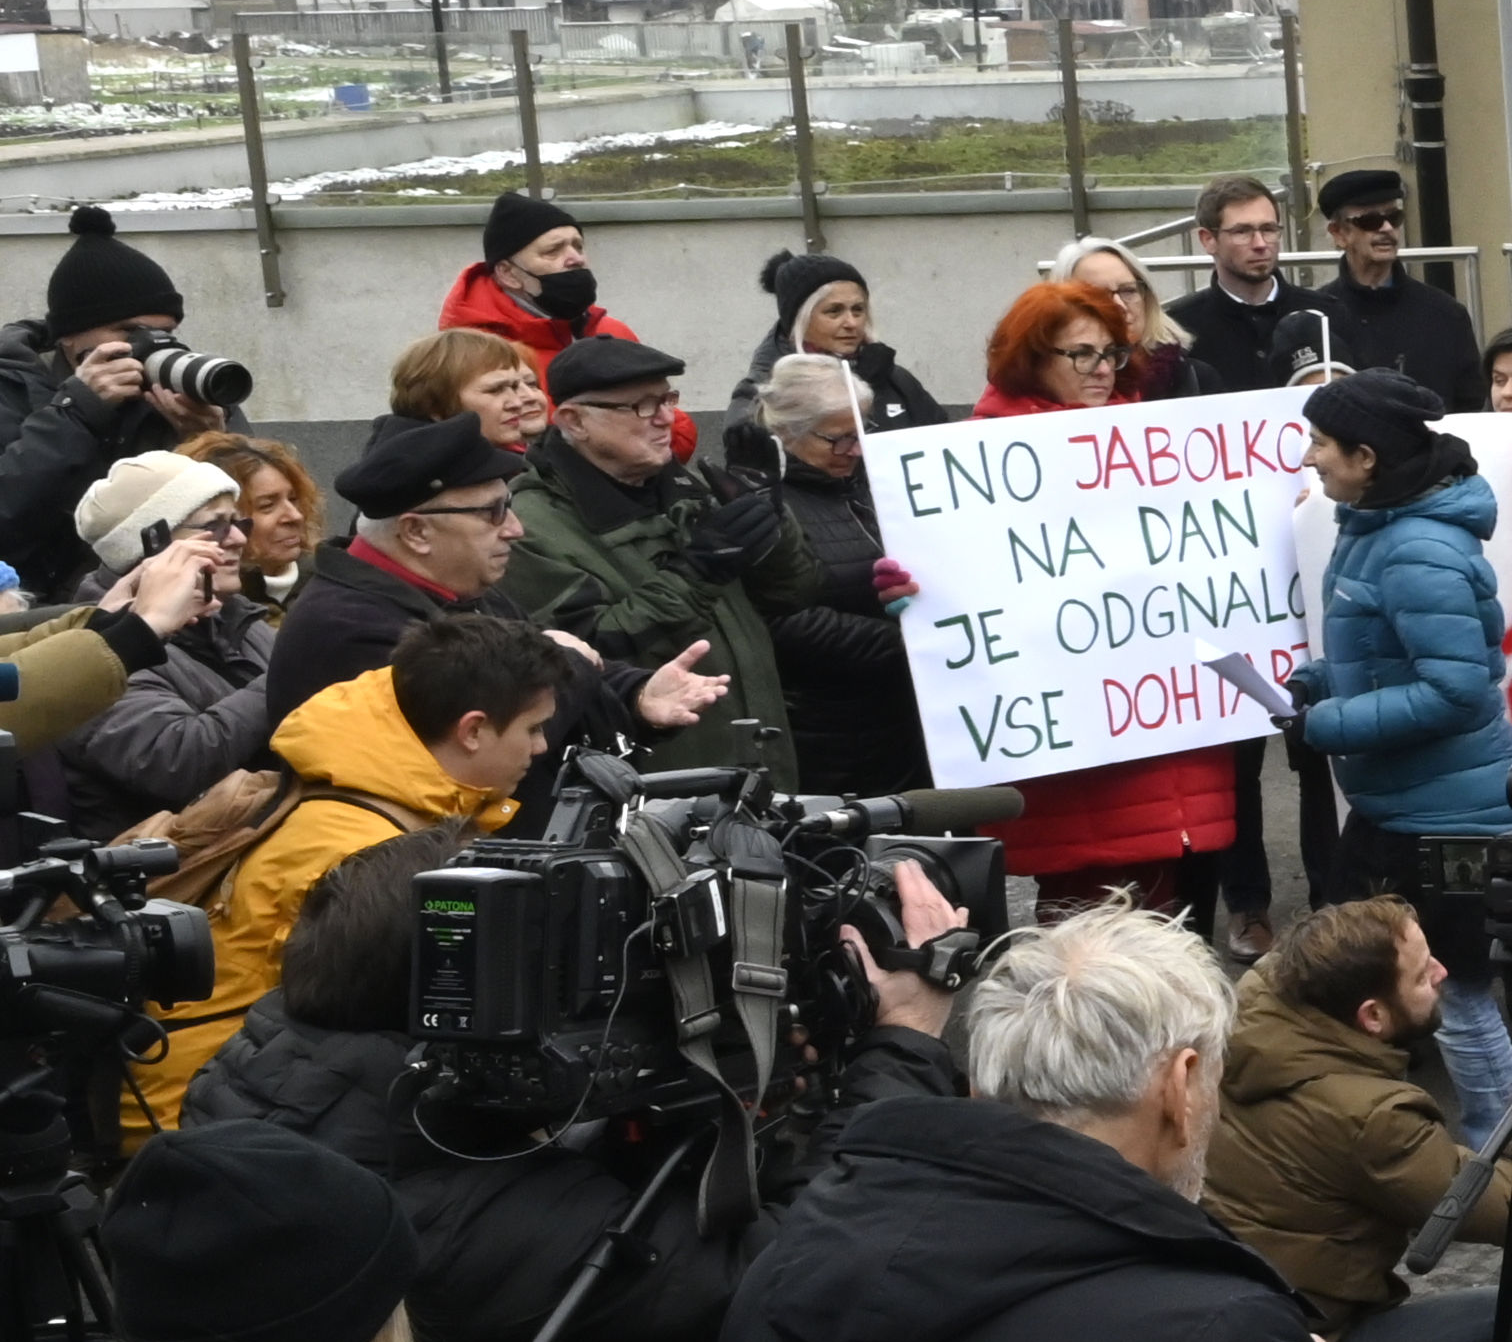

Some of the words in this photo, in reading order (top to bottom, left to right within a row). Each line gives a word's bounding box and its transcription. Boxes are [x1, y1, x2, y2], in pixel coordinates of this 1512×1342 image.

[901, 441, 1042, 517] ENO
[1008, 517, 1105, 583] NA
[1139, 490, 1258, 565] DAN
[934, 609, 1019, 669] JE
[959, 690, 1073, 762] VSE
[1103, 642, 1309, 737] DOHR
[435, 900, 475, 911] PATONA
